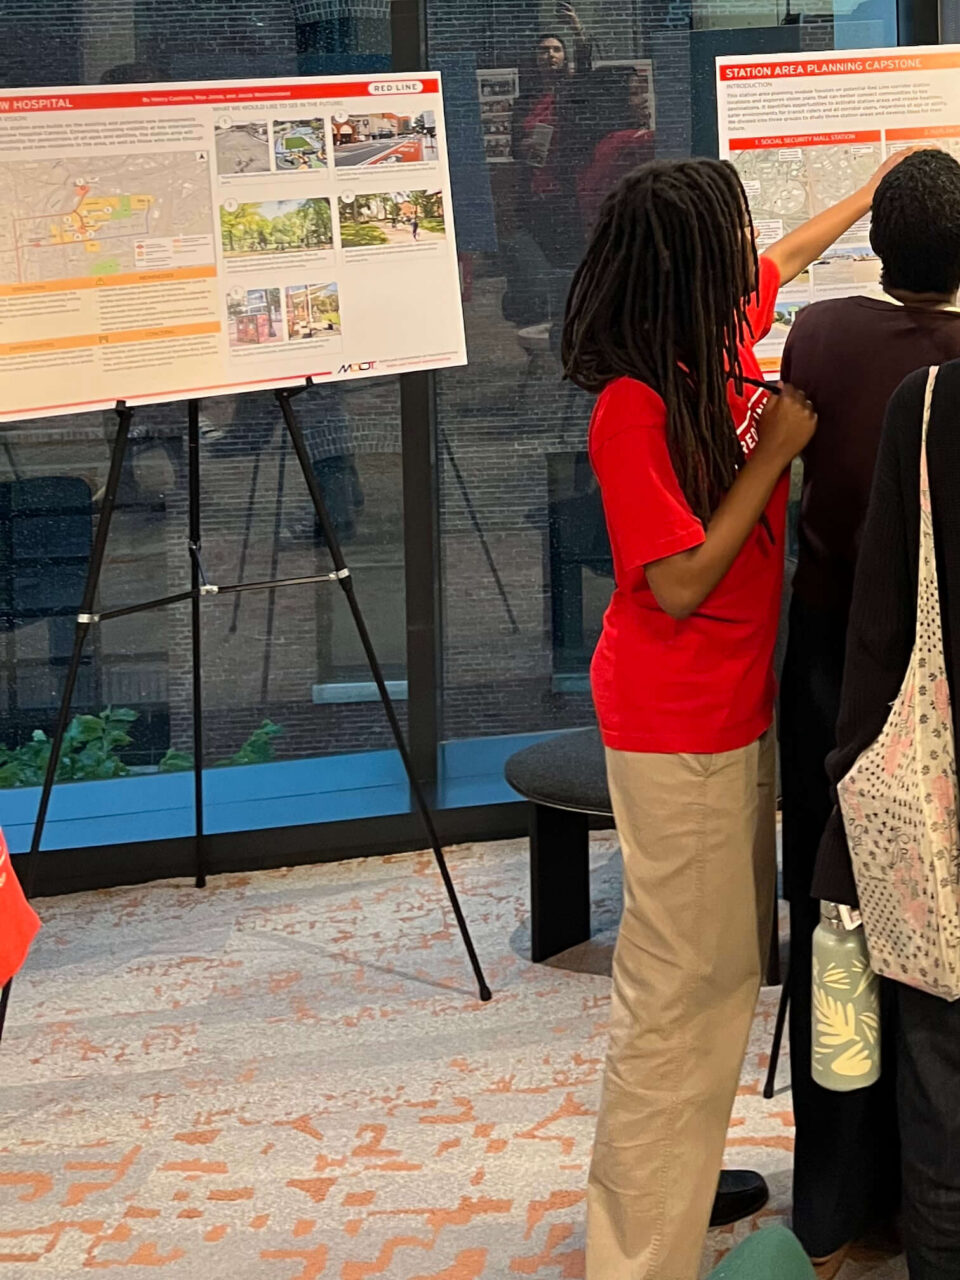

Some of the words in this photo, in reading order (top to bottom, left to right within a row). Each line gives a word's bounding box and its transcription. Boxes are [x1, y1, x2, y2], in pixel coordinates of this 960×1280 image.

[726, 66, 771, 78] STATION
[774, 65, 804, 76] AREA
[808, 62, 863, 74] PLANNING
[866, 58, 922, 70] CAPSTONE
[374, 84, 393, 92] RED
[13, 98, 73, 110] HOSPITAL
